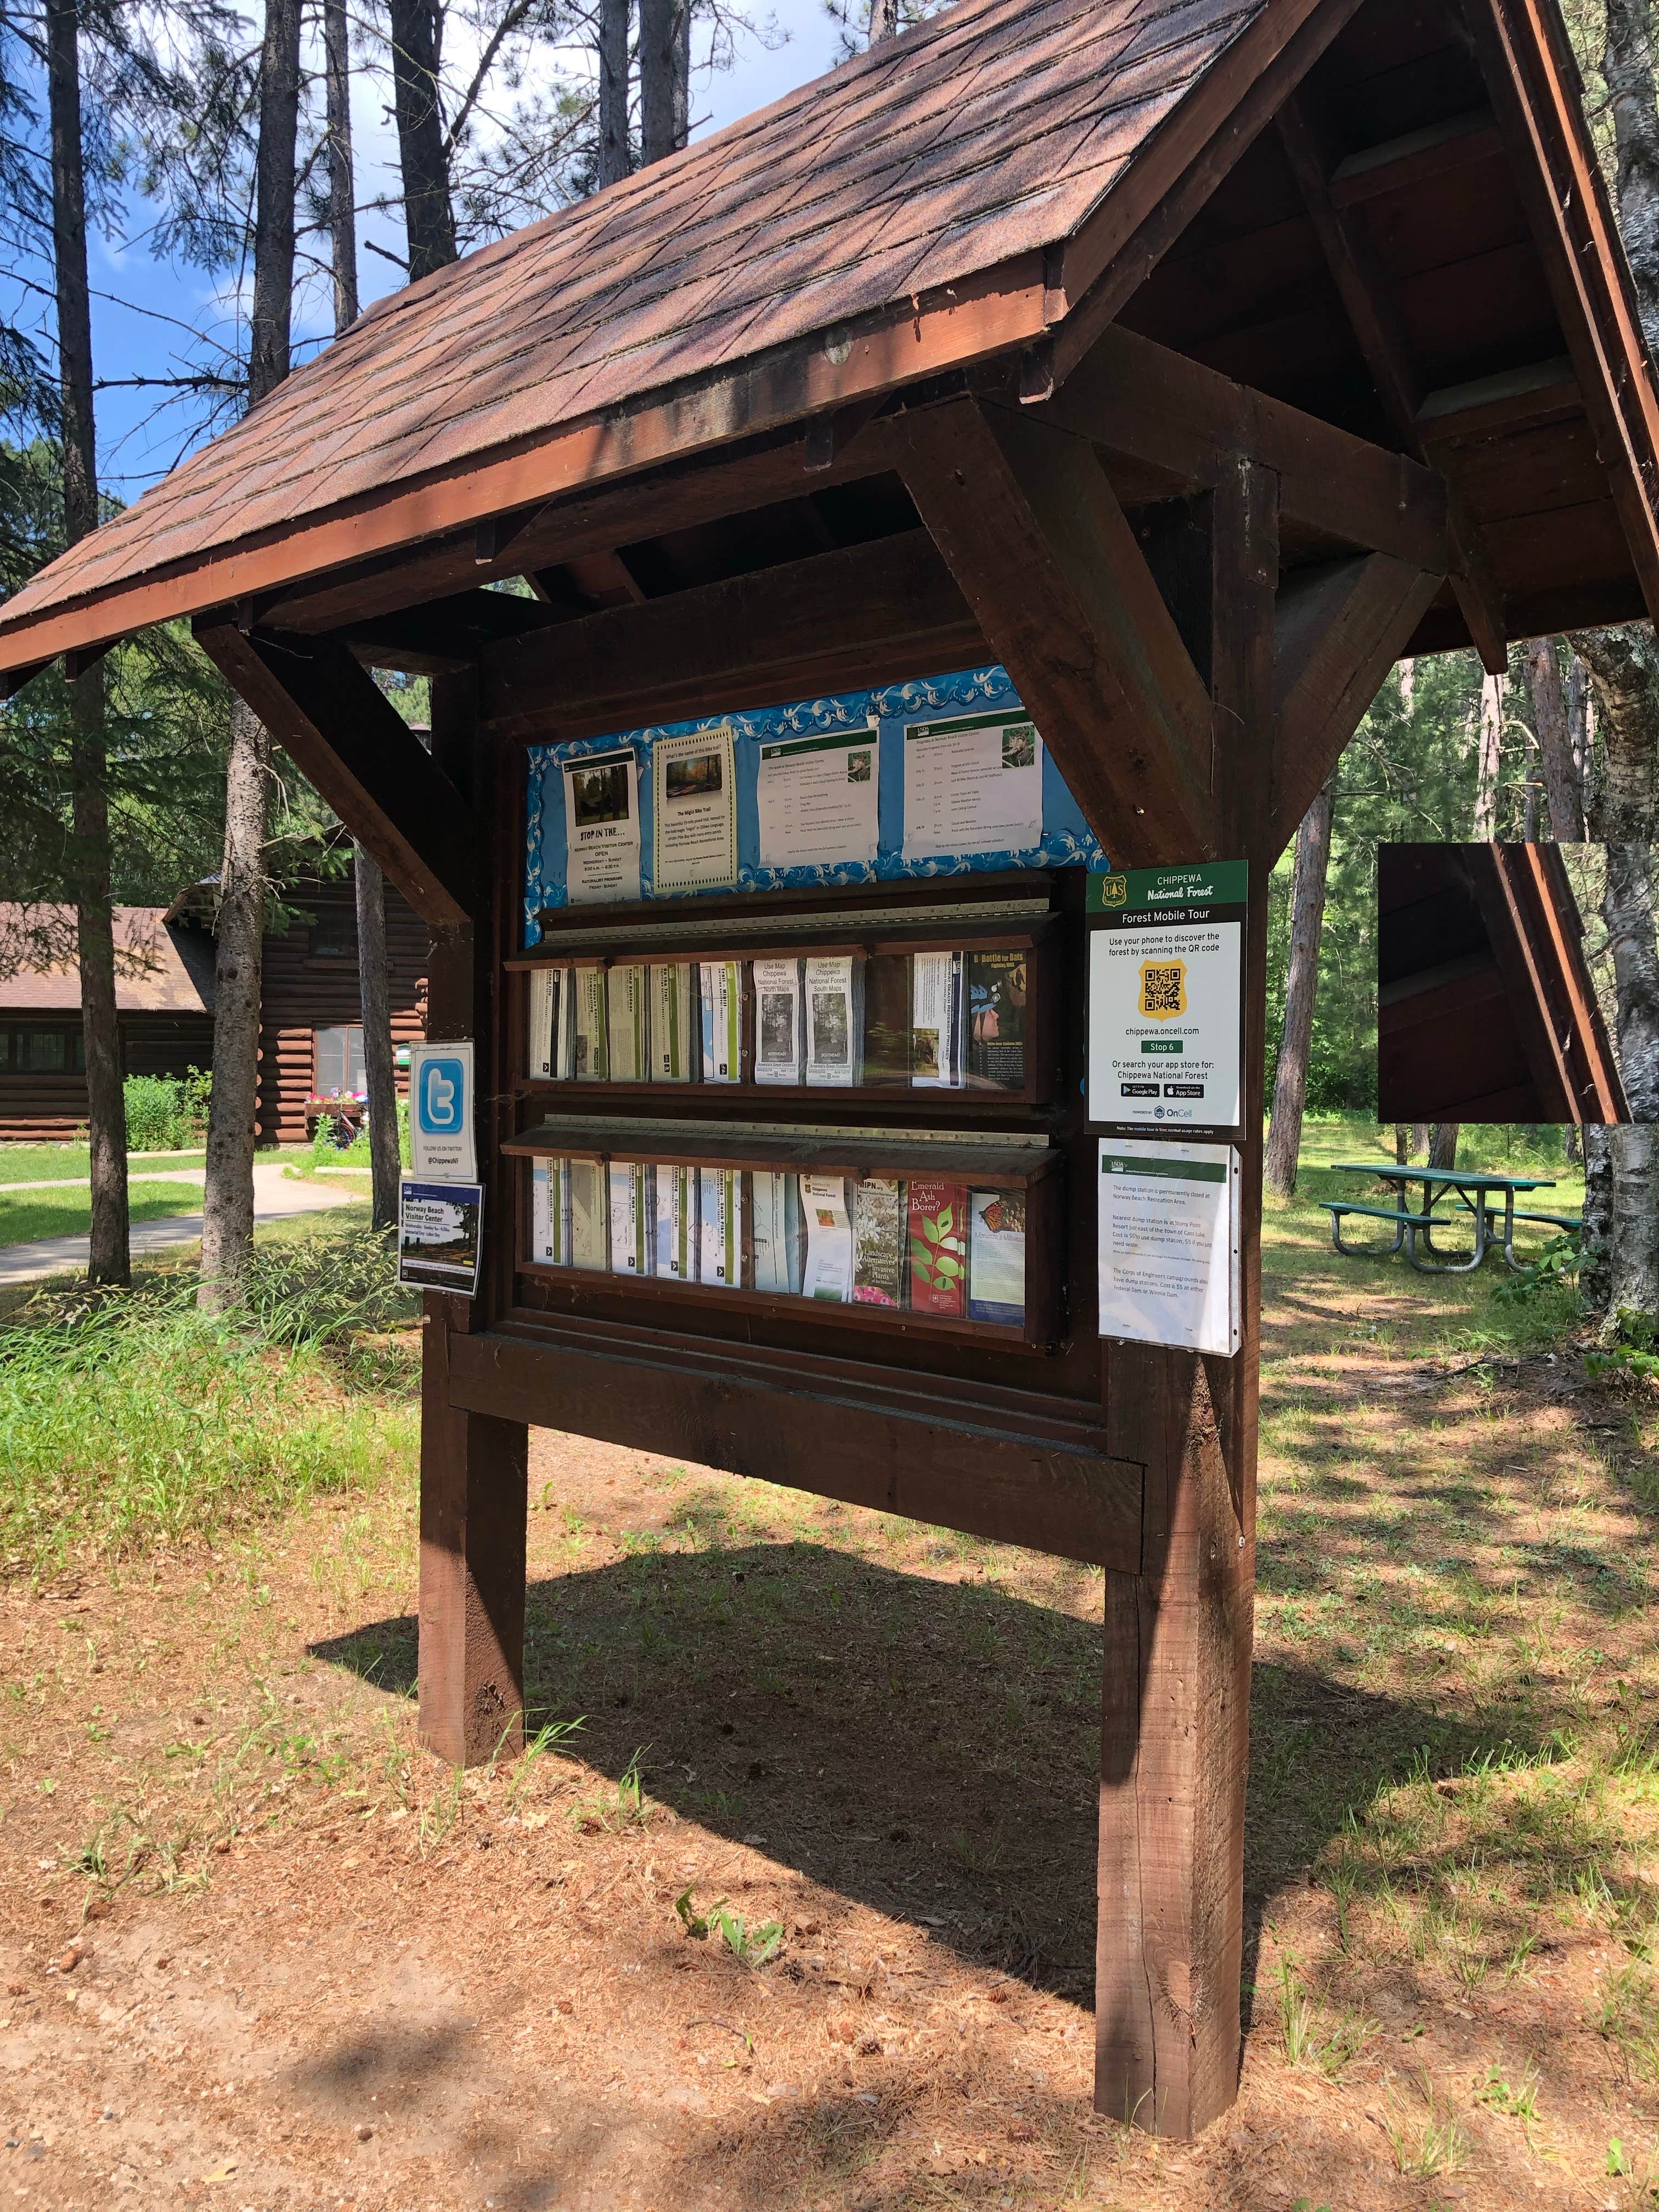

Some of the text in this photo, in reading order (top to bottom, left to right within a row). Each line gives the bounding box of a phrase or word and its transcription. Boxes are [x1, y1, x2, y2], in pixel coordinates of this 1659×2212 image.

[580, 830, 594, 841] STOP
[596, 828, 602, 838] IN
[1158, 874, 1202, 885] CHIPPEWA
[1148, 885, 1214, 901] National Forest
[1122, 909, 1210, 923] Forest Mobile Tour
[1124, 938, 1139, 946] your
[1142, 935, 1164, 945] phone
[1175, 933, 1205, 942] discover
[1109, 947, 1129, 956] forest
[1131, 947, 1139, 956] by
[1141, 946, 1173, 955] scanning
[982, 954, 1001, 962] Battle
[1010, 953, 1023, 961] Bats
[1126, 1027, 1199, 1036] chippewa.oncell.com
[1150, 1043, 1167, 1052] Stop
[1118, 1071, 1151, 1080] Chippewa
[1166, 1109, 1192, 1118] OnCell
[911, 1181, 945, 1190] Emerald
[919, 1190, 935, 1201] Ash
[1159, 1189, 1190, 1198] permanently
[912, 1198, 940, 1211] Borer?
[406, 1205, 426, 1214] Norway
[863, 1255, 895, 1265] Alternatives
[872, 1264, 895, 1273] Invasive
[872, 1272, 889, 1280] Plants
[1143, 1271, 1166, 1279] Engineers
[1166, 1274, 1199, 1283] campgrounds
